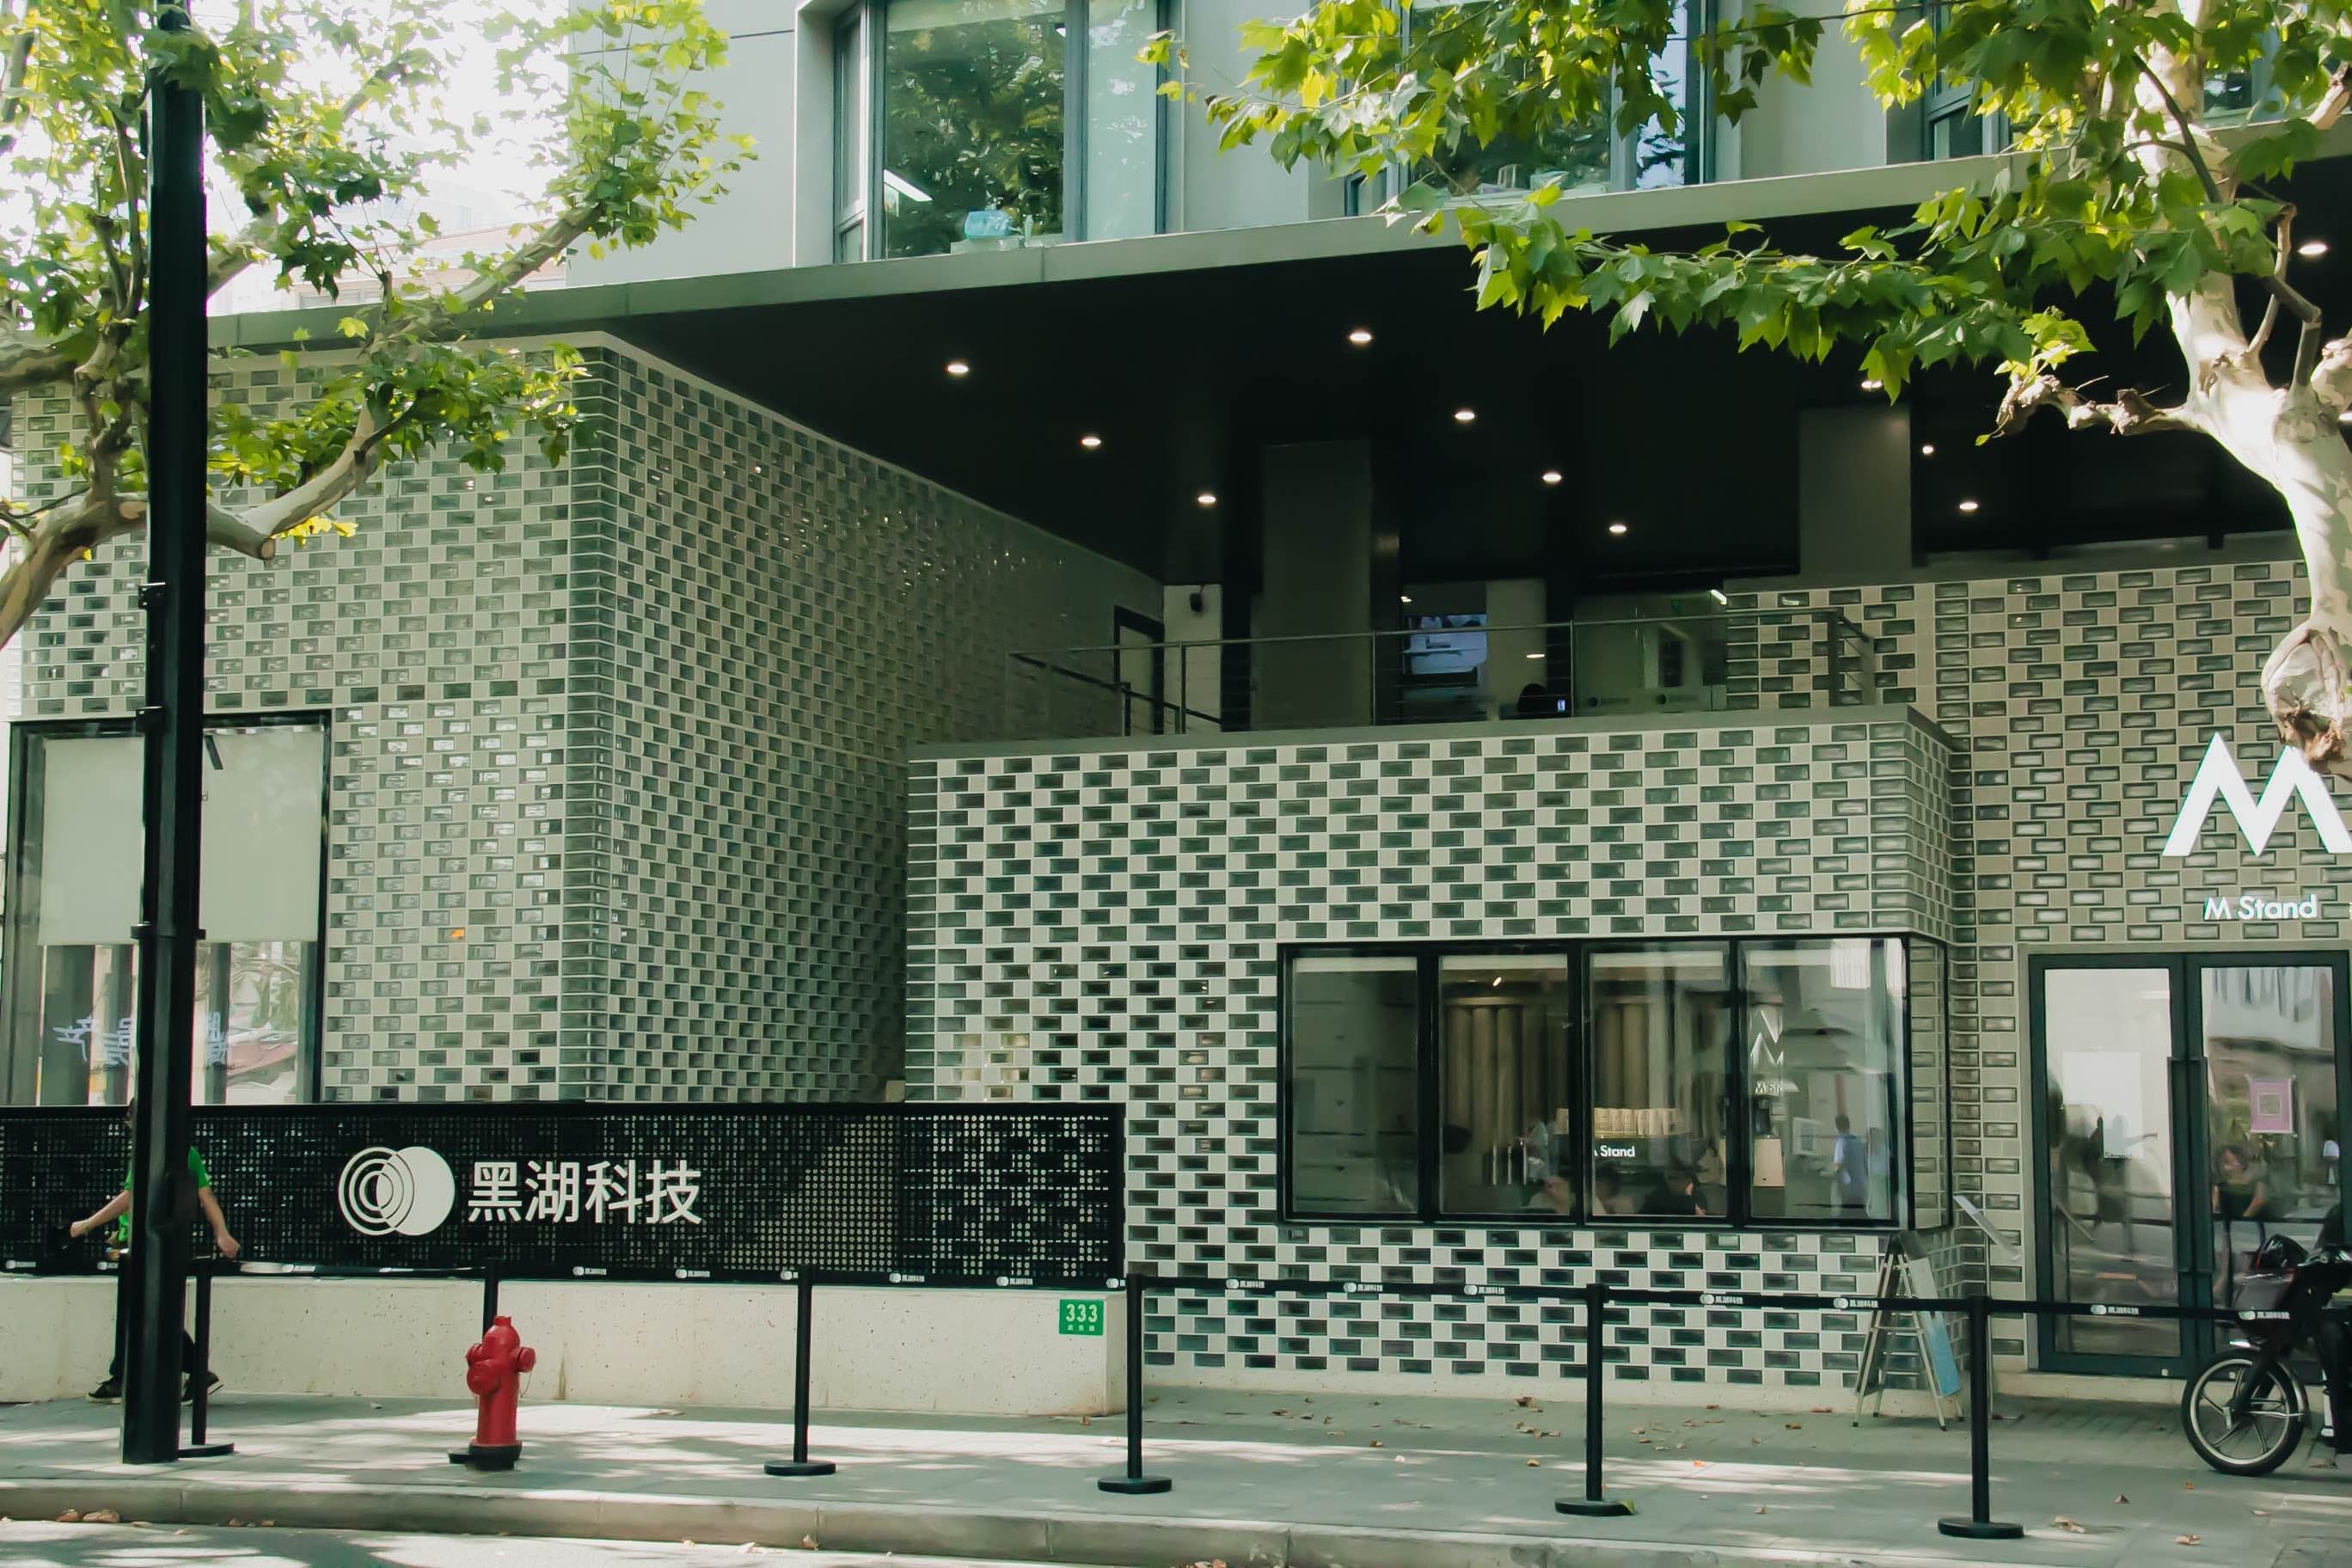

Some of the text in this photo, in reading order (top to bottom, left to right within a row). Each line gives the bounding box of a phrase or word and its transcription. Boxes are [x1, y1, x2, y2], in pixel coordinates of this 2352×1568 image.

[2162, 732, 2352, 857] M
[2204, 894, 2318, 921] M Stand
[1600, 1144, 1636, 1158] Stand
[468, 1160, 703, 1224] 黑湖科技
[1066, 1303, 1098, 1323] 333
